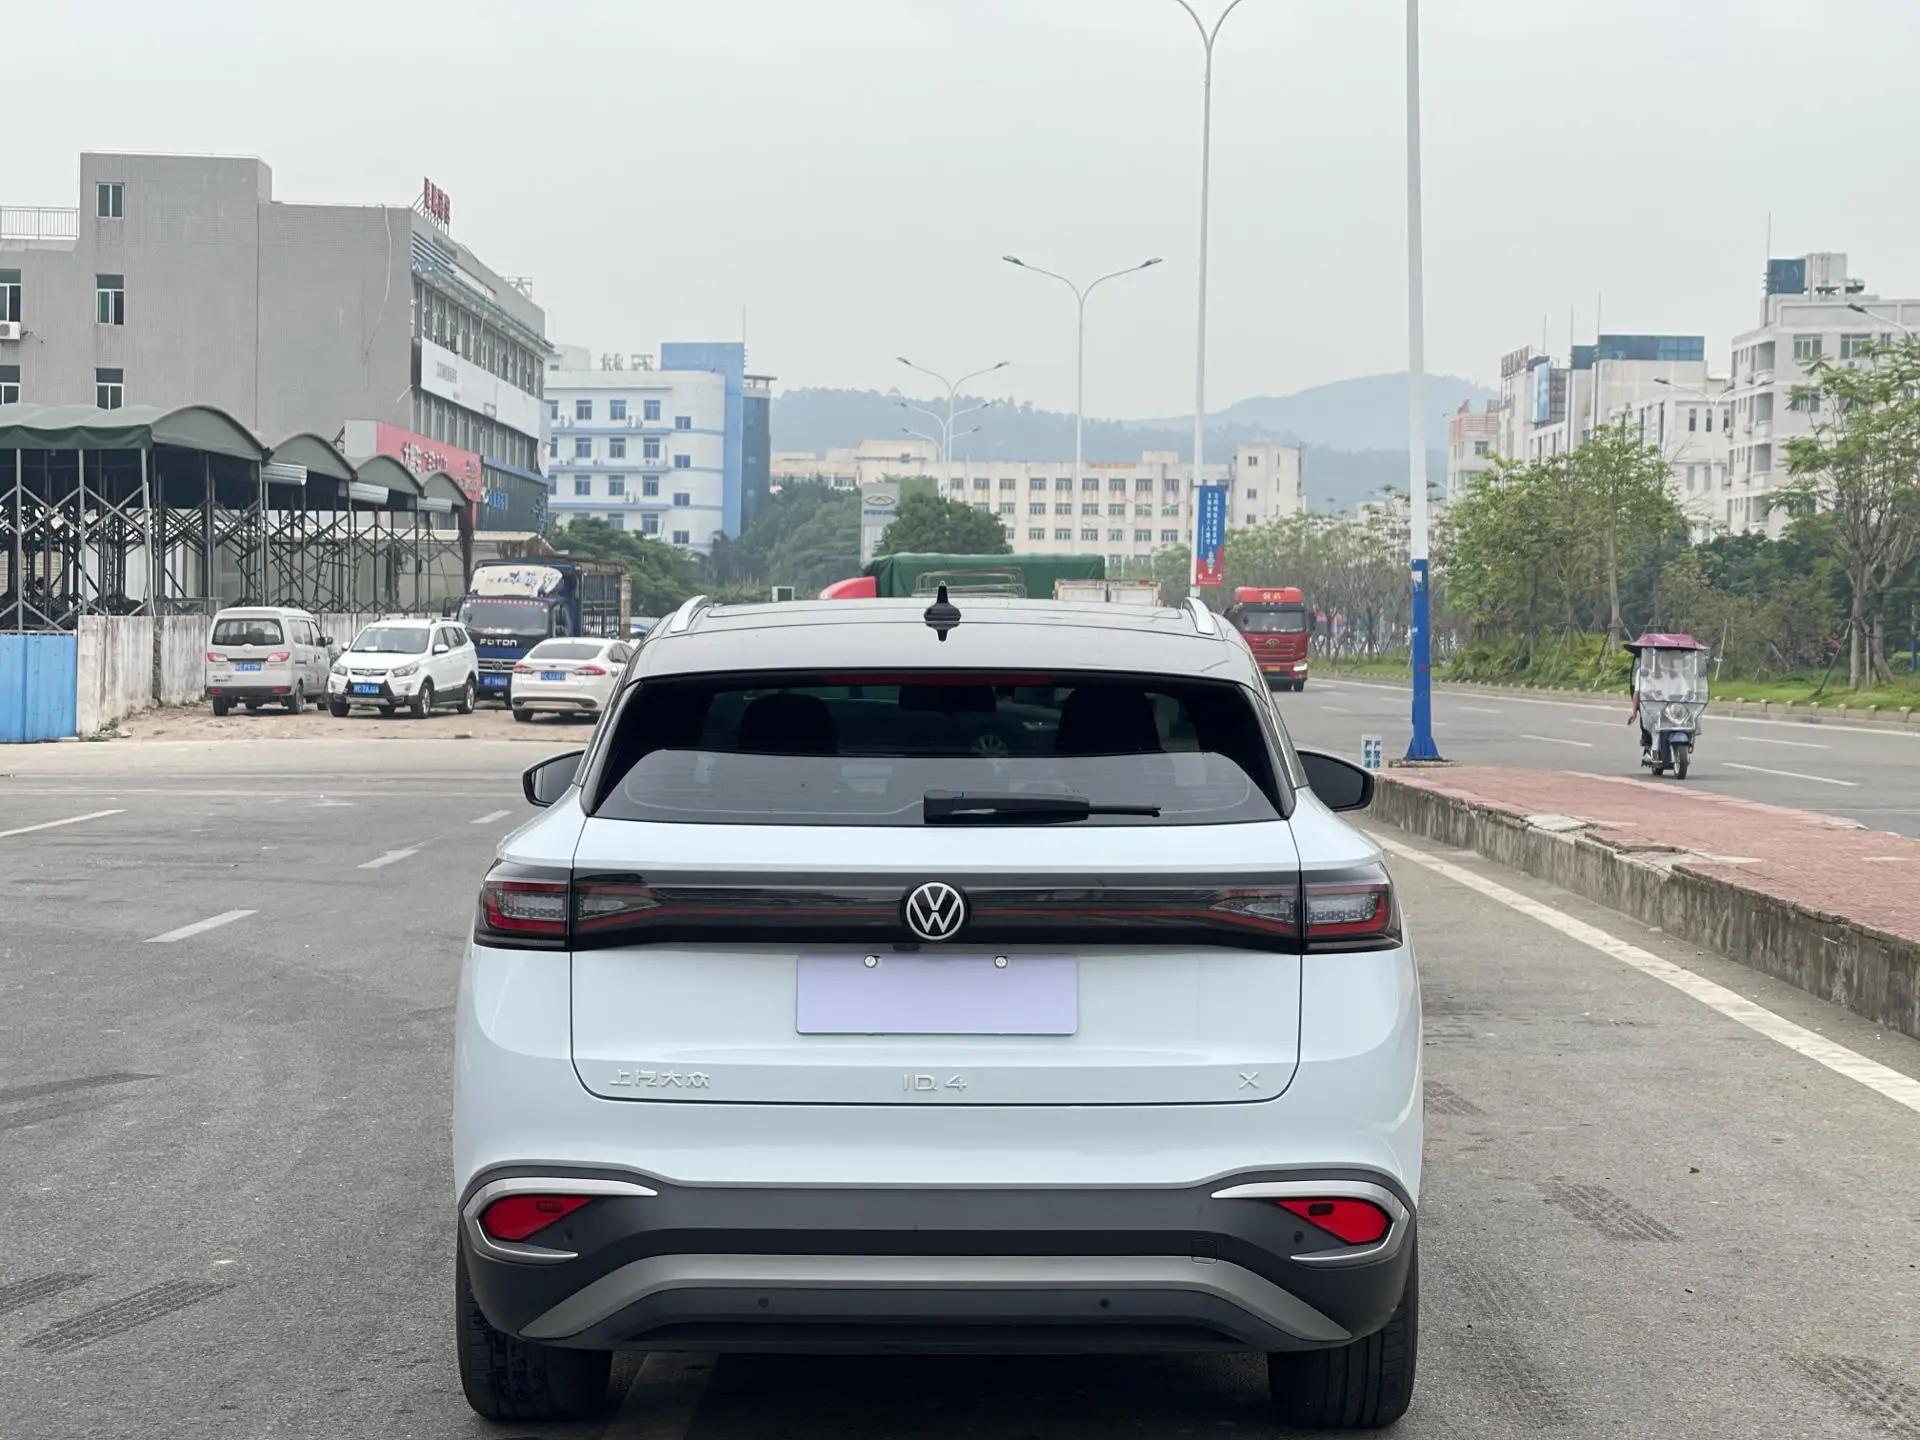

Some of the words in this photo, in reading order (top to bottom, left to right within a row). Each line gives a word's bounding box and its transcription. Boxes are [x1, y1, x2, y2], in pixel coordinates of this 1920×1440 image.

[479, 638, 518, 647] FOTON
[609, 1069, 710, 1089] 上汽大众
[1239, 1071, 1259, 1090] X
